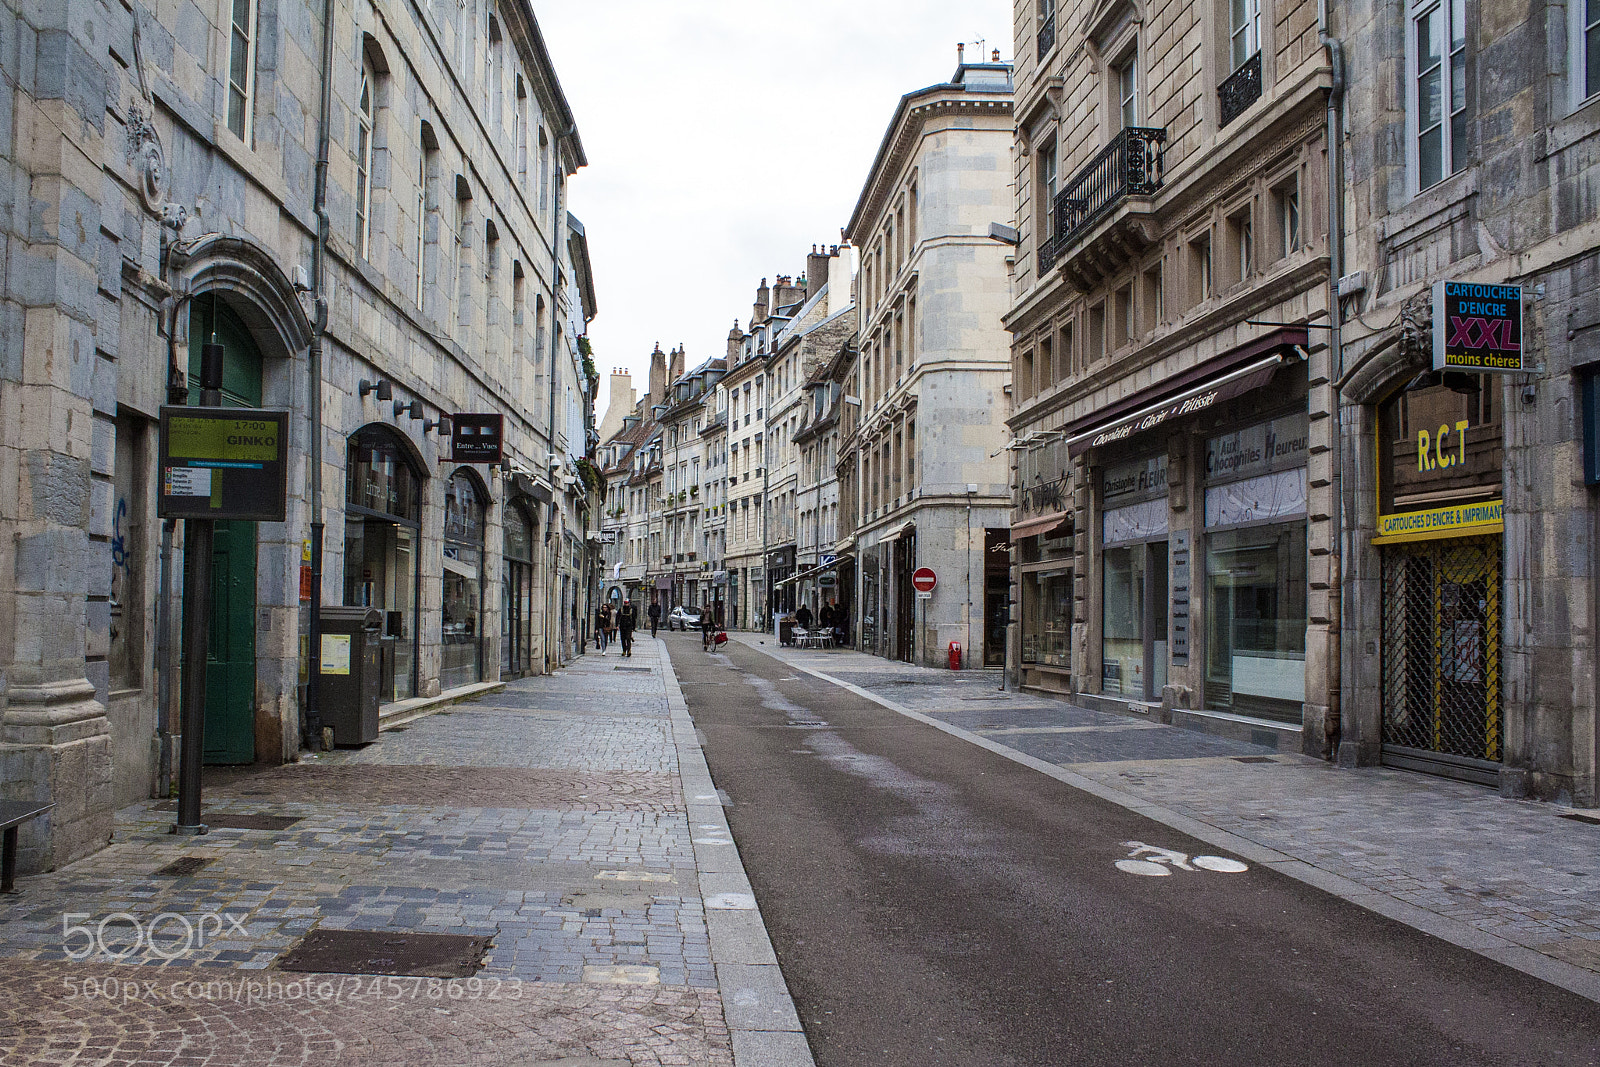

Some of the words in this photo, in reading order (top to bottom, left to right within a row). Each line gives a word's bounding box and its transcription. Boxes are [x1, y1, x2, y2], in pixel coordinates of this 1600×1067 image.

[1445, 283, 1520, 300] CARTOUCHES
[1459, 301, 1506, 316] D'ENCRE
[1447, 316, 1520, 351] XXL
[1446, 352, 1481, 365] moins
[1484, 353, 1520, 368] chères
[235, 421, 266, 431] 17:00
[226, 435, 276, 447] GINKO
[482, 442, 498, 450] Vues
[1418, 419, 1469, 472] R.C.T
[1104, 474, 1136, 494] Christophe
[1384, 513, 1425, 532] CARTOUCHES
[1425, 510, 1454, 528] D'ENCRE
[1456, 509, 1461, 524] &
